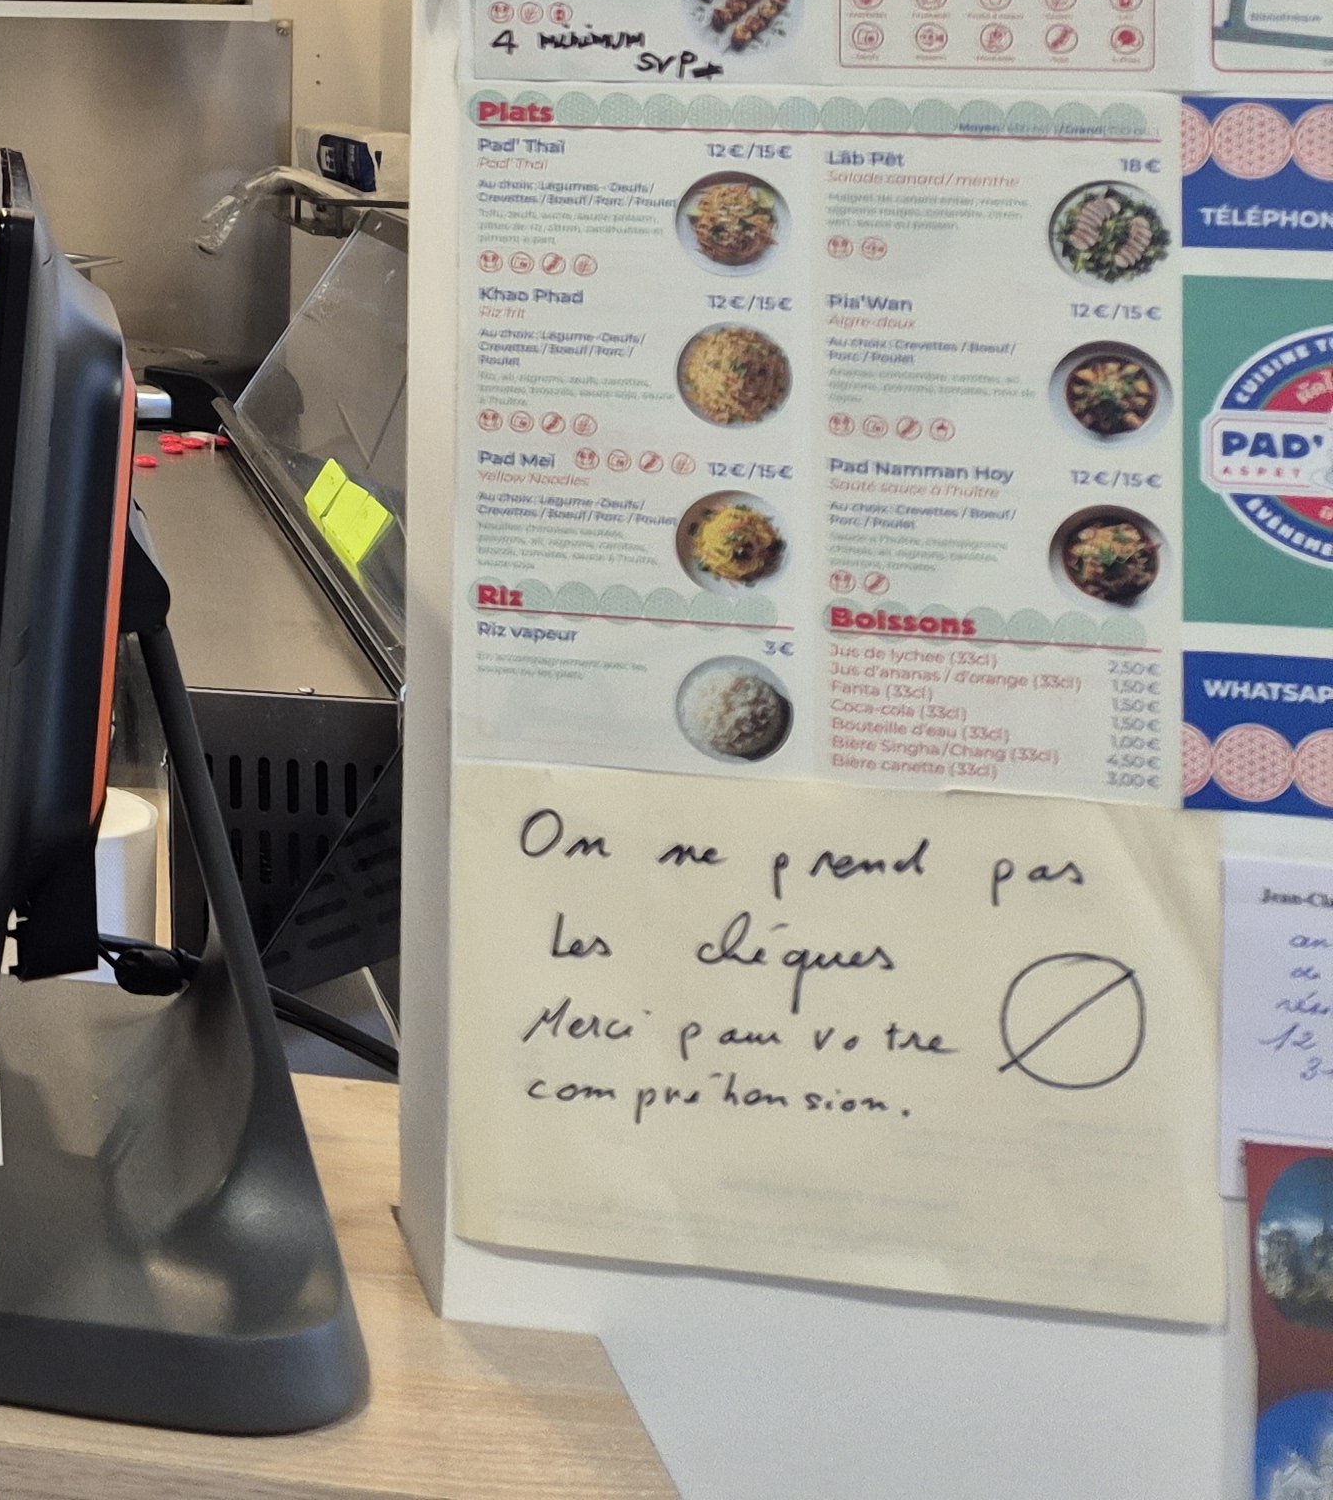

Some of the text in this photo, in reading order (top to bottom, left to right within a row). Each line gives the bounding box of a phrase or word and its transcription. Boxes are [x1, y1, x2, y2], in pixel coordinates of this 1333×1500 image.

[492, 29, 520, 56] 4
[478, 101, 554, 123] Plats
[828, 170, 884, 184] Salade
[479, 286, 584, 304] Khao Phad
[1221, 430, 1324, 460] PAD'
[479, 450, 516, 466] Pad
[830, 457, 1014, 485] Pad Namman Hoy
[830, 477, 877, 493] Sauté
[881, 481, 928, 496] sauce
[478, 584, 525, 608] Riz
[830, 606, 978, 637] Boissons
[478, 620, 579, 643] Riz vapeur
[830, 643, 860, 660] Jus
[865, 647, 886, 660] de
[830, 661, 860, 677] Jus
[832, 679, 881, 697] Fanta
[830, 698, 916, 717] Coca-cola
[832, 716, 908, 735] Bouteille
[519, 808, 1086, 906] On ne prend pas
